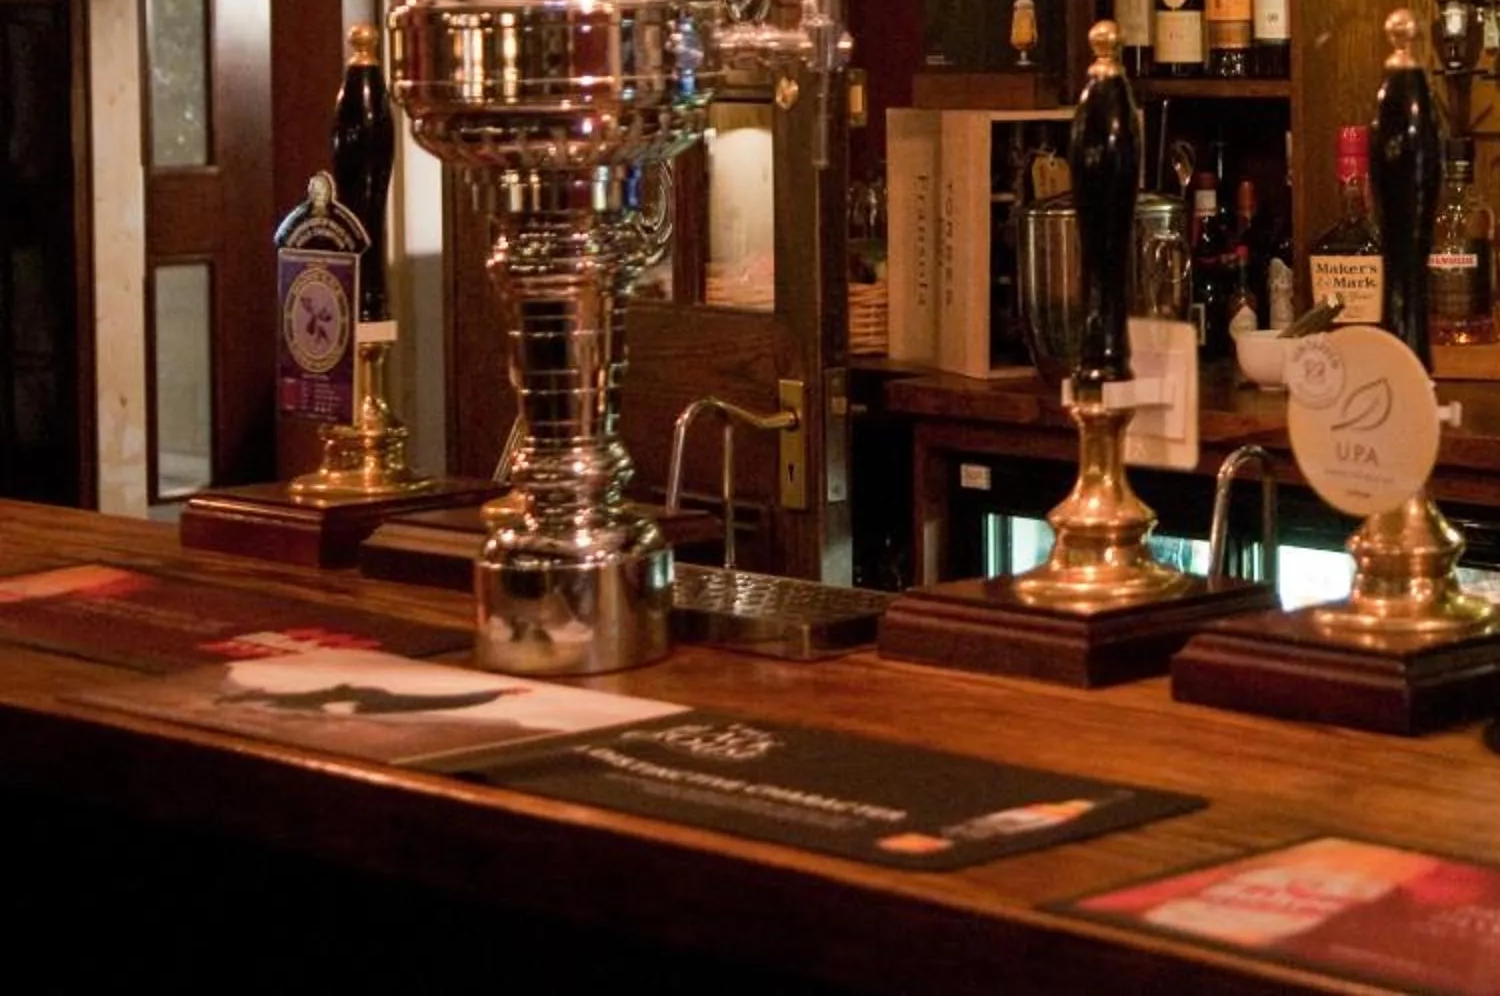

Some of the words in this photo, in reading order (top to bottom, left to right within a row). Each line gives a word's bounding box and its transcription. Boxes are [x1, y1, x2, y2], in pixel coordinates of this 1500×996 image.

[1316, 262, 1377, 275] Maker's
[1333, 275, 1377, 289] Mark
[1336, 442, 1379, 468] UPA
